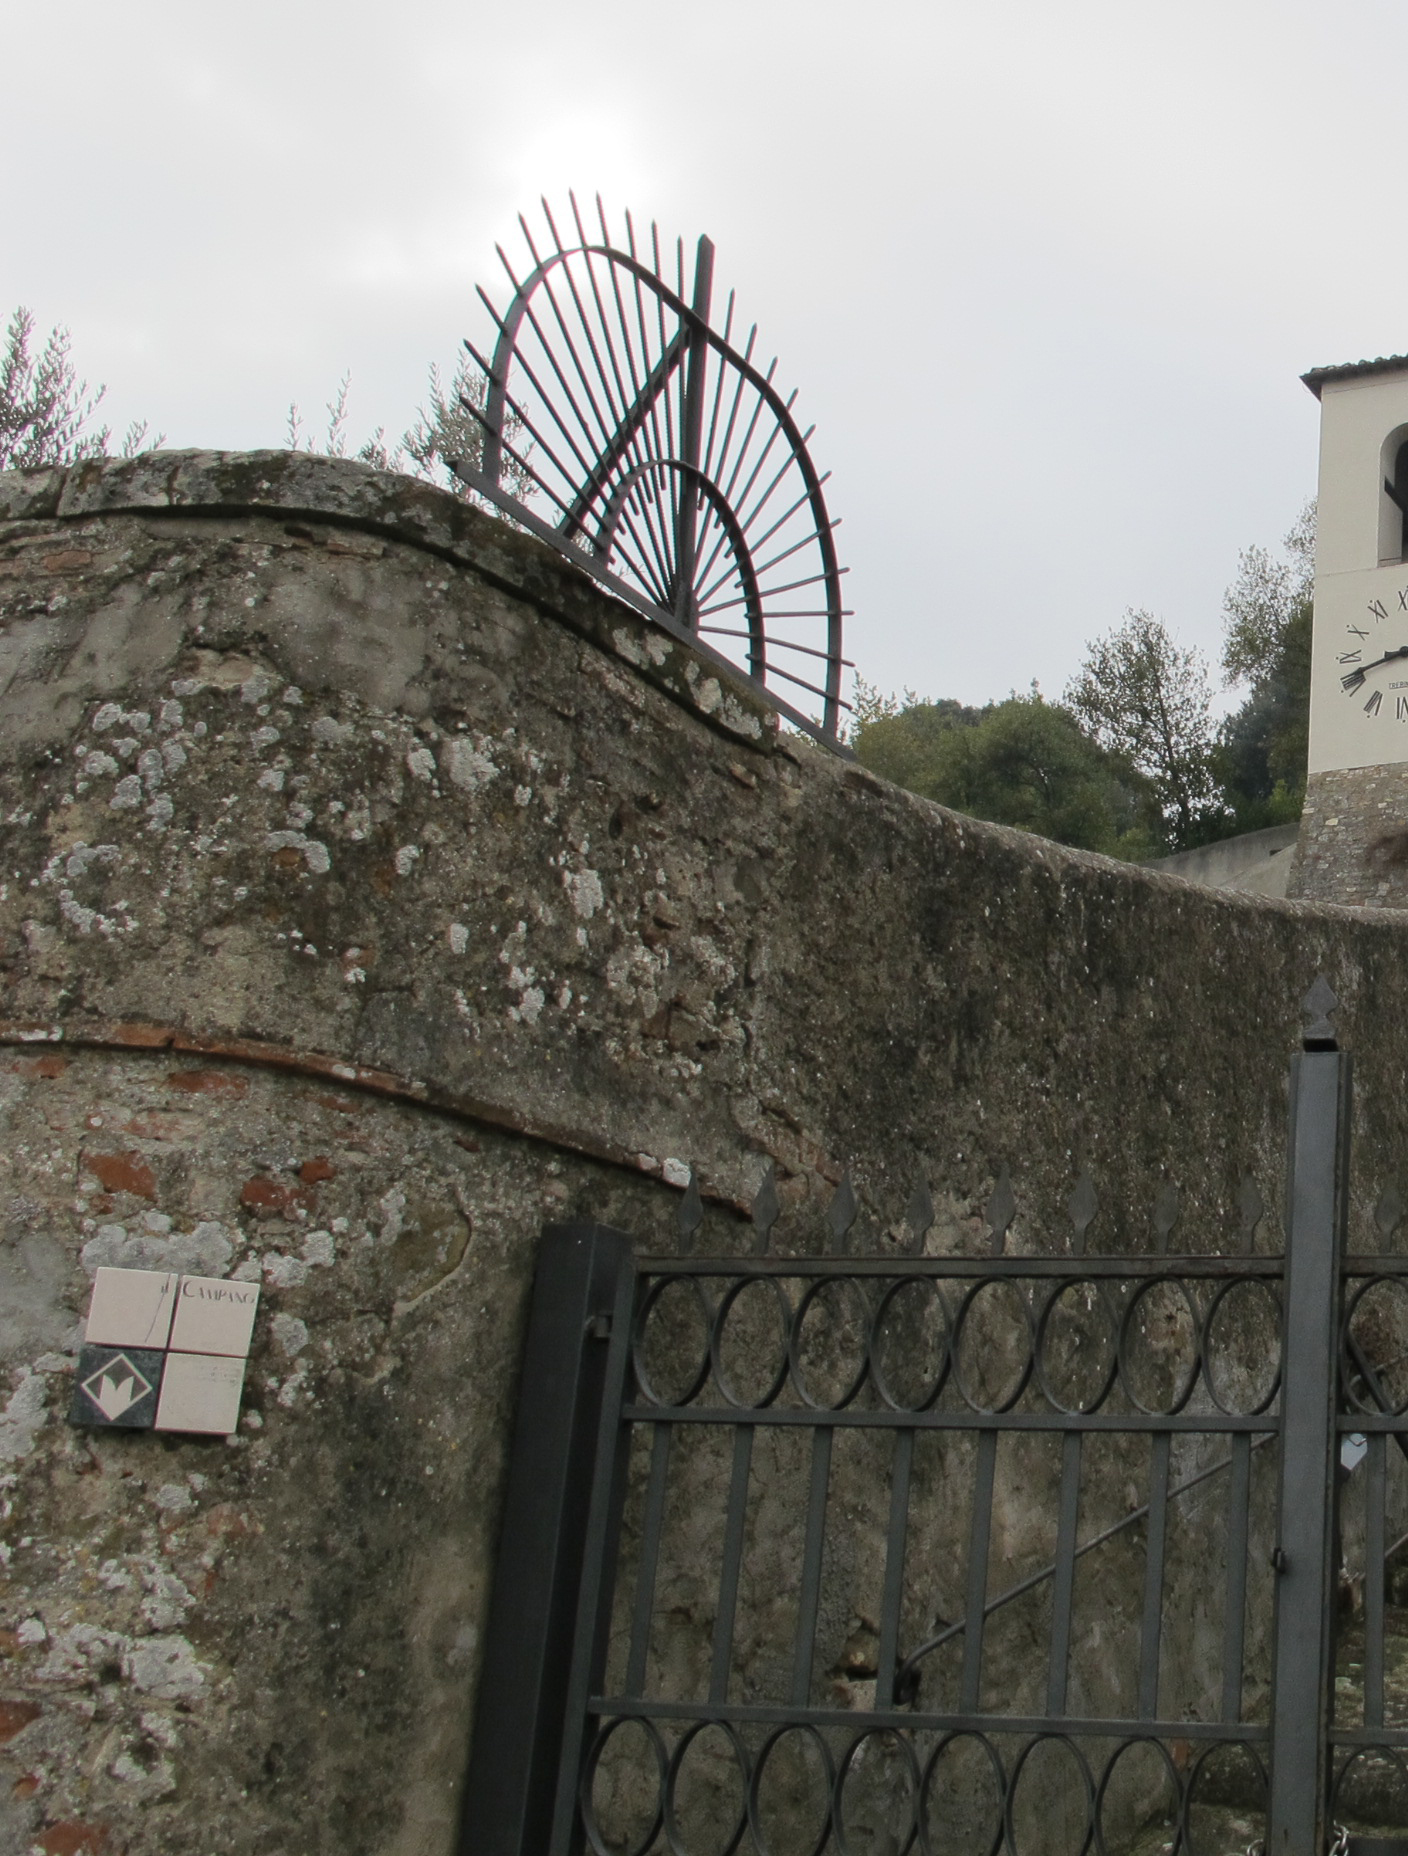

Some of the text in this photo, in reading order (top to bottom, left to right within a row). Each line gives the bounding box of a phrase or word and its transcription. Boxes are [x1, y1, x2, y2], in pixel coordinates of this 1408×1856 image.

[1367, 599, 1389, 624] XI
[1347, 624, 1370, 641] X
[1339, 649, 1362, 664] IX
[1363, 690, 1383, 716] VII
